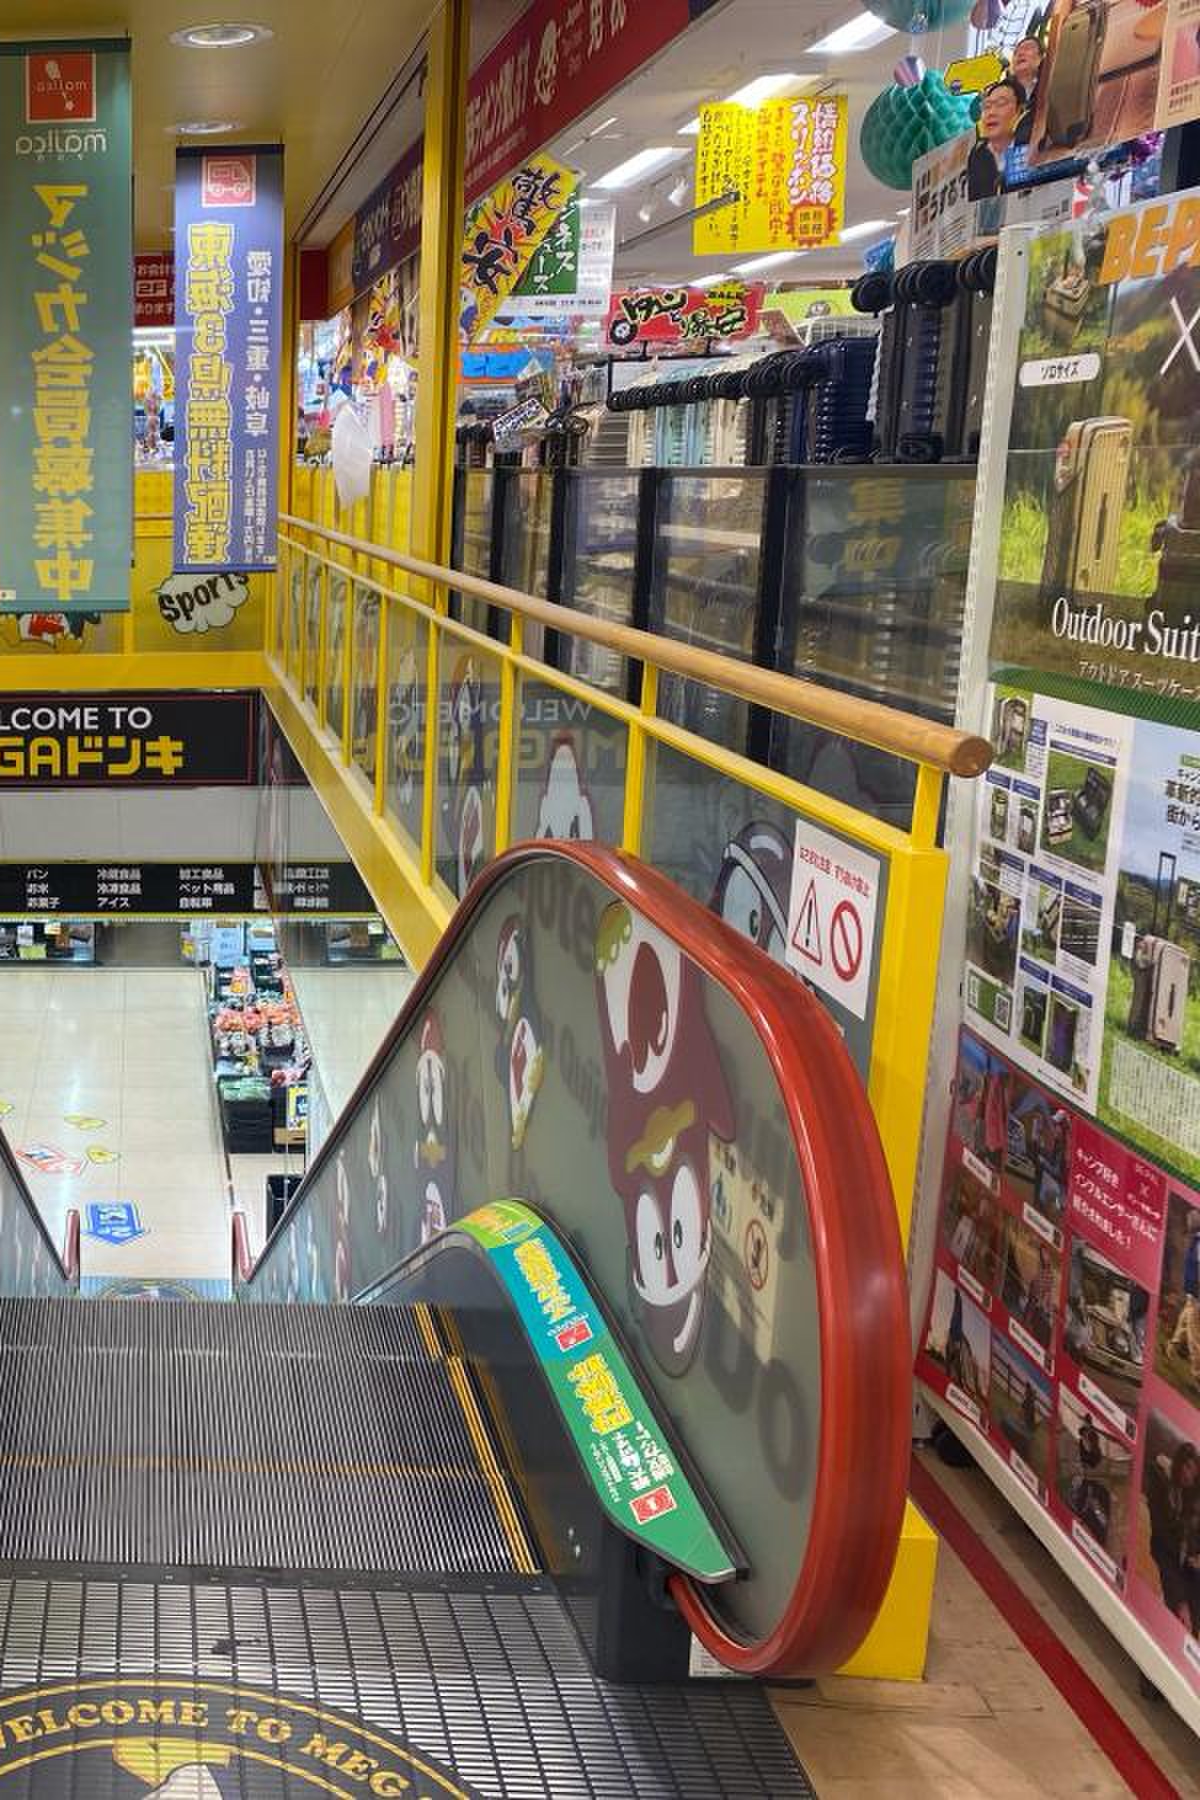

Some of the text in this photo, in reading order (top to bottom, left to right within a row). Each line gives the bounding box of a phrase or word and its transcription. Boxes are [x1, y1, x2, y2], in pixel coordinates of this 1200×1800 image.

[1052, 597, 1142, 651] Outdoor
[108, 706, 153, 730] TO
[27, 869, 49, 880] パン
[97, 898, 130, 909] アイス
[226, 1708, 294, 1744] TO
[300, 1731, 430, 1800] MEG
